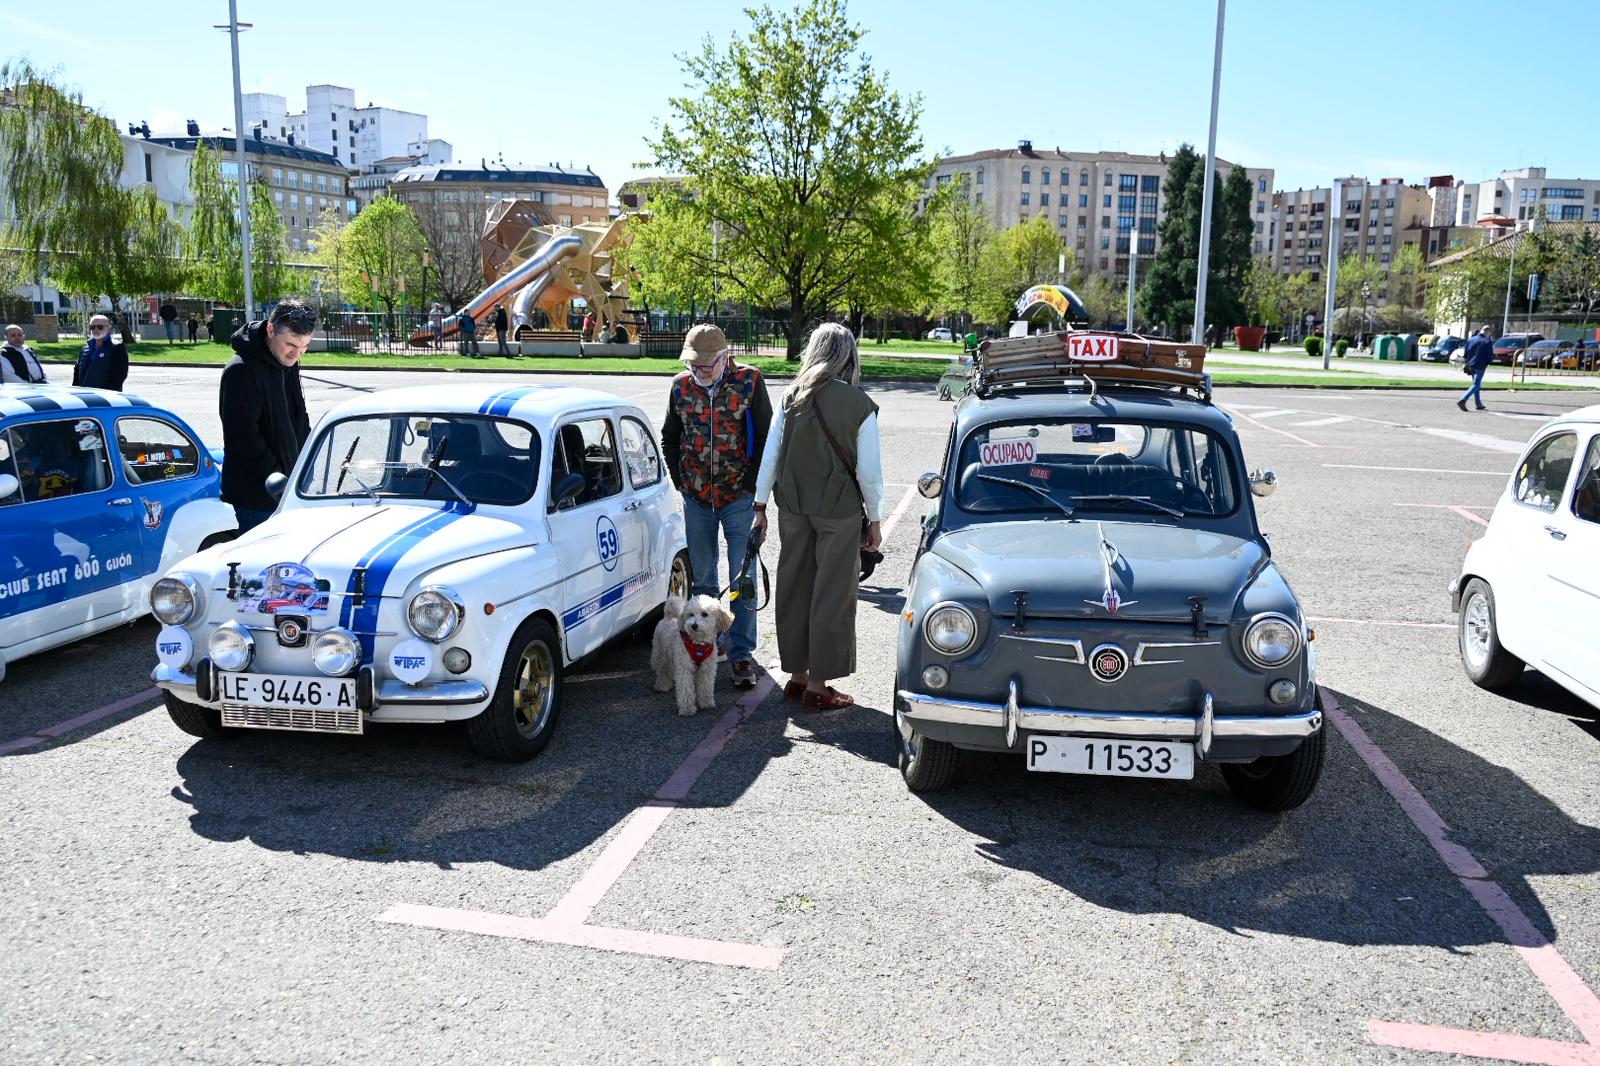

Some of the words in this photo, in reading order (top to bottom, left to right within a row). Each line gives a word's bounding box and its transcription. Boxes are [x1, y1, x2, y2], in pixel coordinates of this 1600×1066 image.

[1071, 338, 1115, 357] TAXI
[983, 441, 1034, 465] OCUPADO
[1030, 467, 1049, 480] LIBRE
[598, 528, 618, 560] 59
[0, 577, 30, 600] CLUB
[36, 567, 68, 591] SEAT
[74, 559, 101, 581] 600
[284, 569, 291, 577] 9
[159, 642, 182, 655] WIPAC
[393, 656, 425, 670] WIPAC
[261, 678, 322, 706] 9446
[1030, 740, 1048, 767] P
[1084, 743, 1173, 774] 11533
